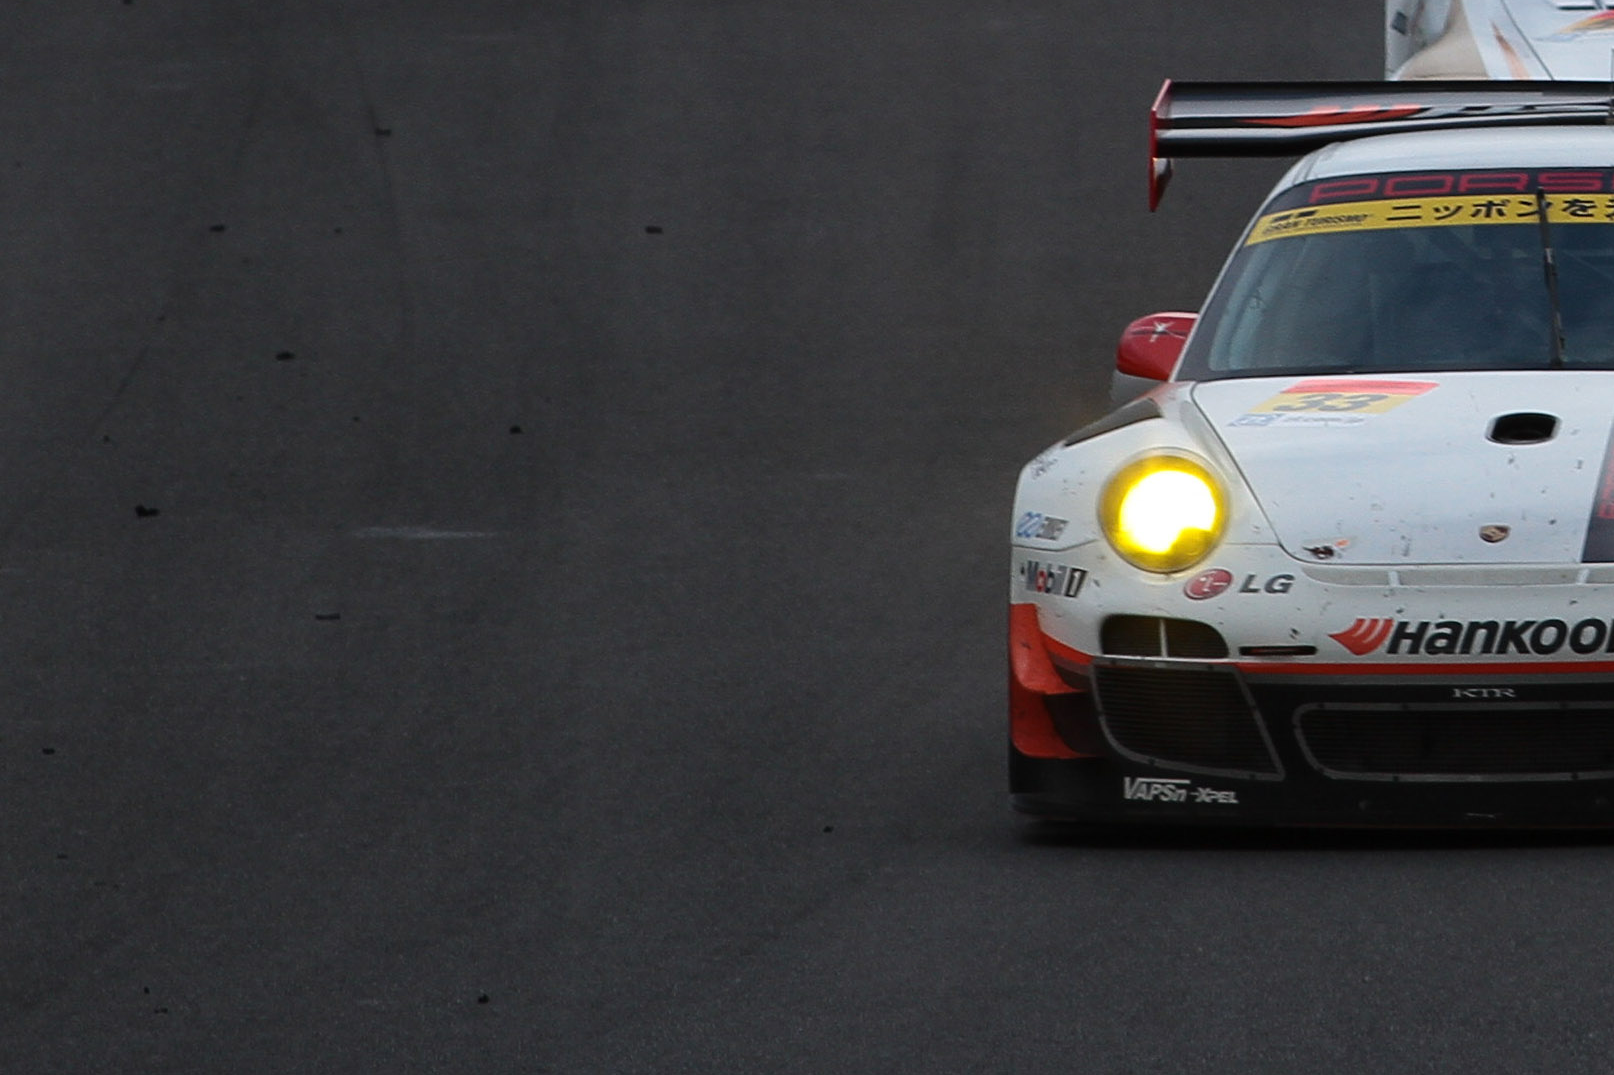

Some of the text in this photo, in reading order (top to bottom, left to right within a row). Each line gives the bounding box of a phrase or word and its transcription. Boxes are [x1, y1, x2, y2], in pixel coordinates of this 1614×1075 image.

[1273, 392, 1388, 412] 33
[1239, 574, 1295, 594] LG
[1452, 687, 1517, 699] KTR
